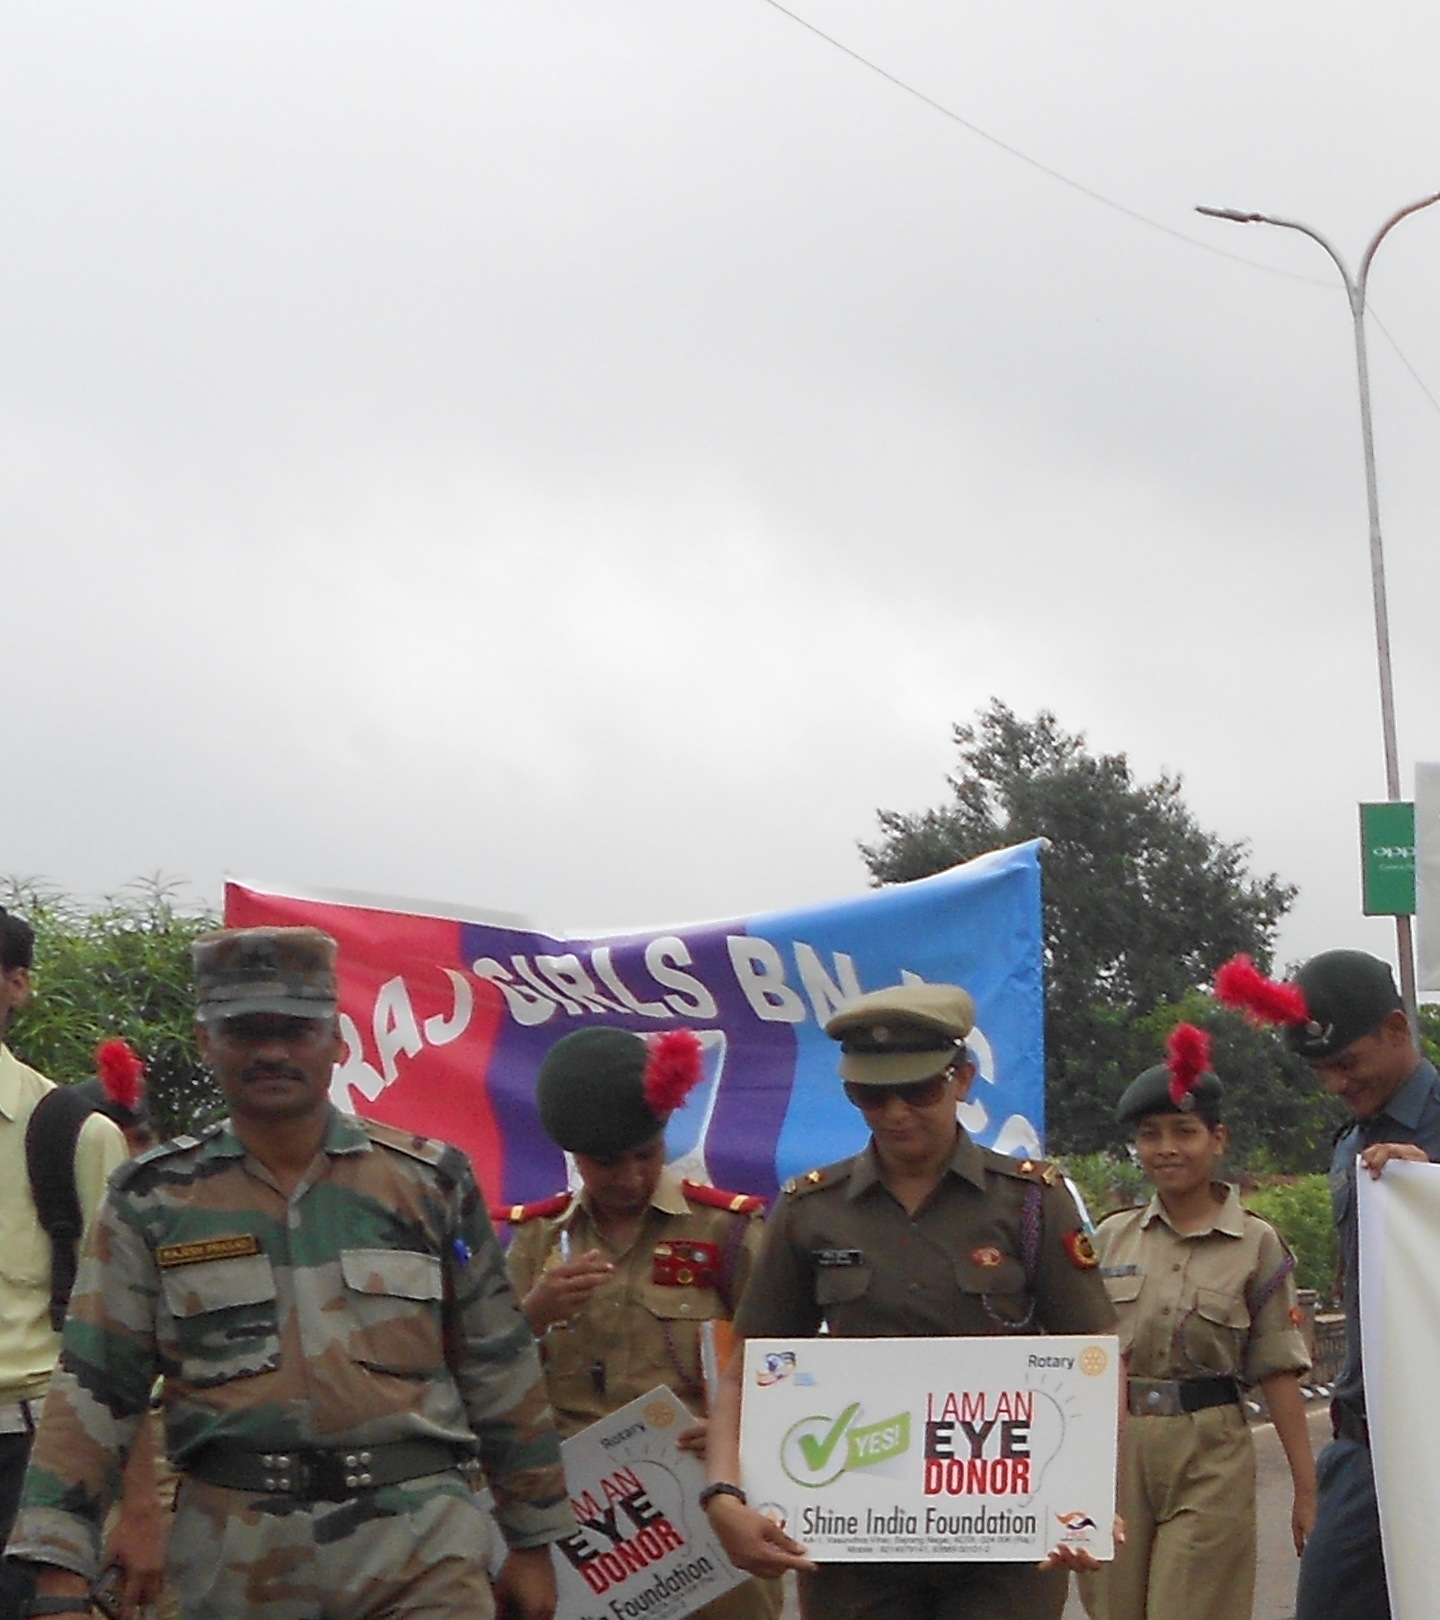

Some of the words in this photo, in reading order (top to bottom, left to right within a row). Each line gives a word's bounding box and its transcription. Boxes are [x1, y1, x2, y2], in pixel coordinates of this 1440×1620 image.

[473, 936, 719, 1026] GIRLS
[1028, 1354, 1075, 1370] Rotary
[927, 1392, 933, 1421] I
[941, 1391, 987, 1421] AM
[998, 1391, 1034, 1421] AN
[854, 1428, 900, 1458] YES!
[923, 1420, 1031, 1459] EYE
[600, 1466, 644, 1506] AN
[923, 1458, 1031, 1495] DONOR
[555, 1489, 664, 1571] EYE
[802, 1506, 858, 1535] Shine
[867, 1506, 917, 1535] India
[925, 1505, 1037, 1535] Foundation
[579, 1518, 685, 1596] DONOR
